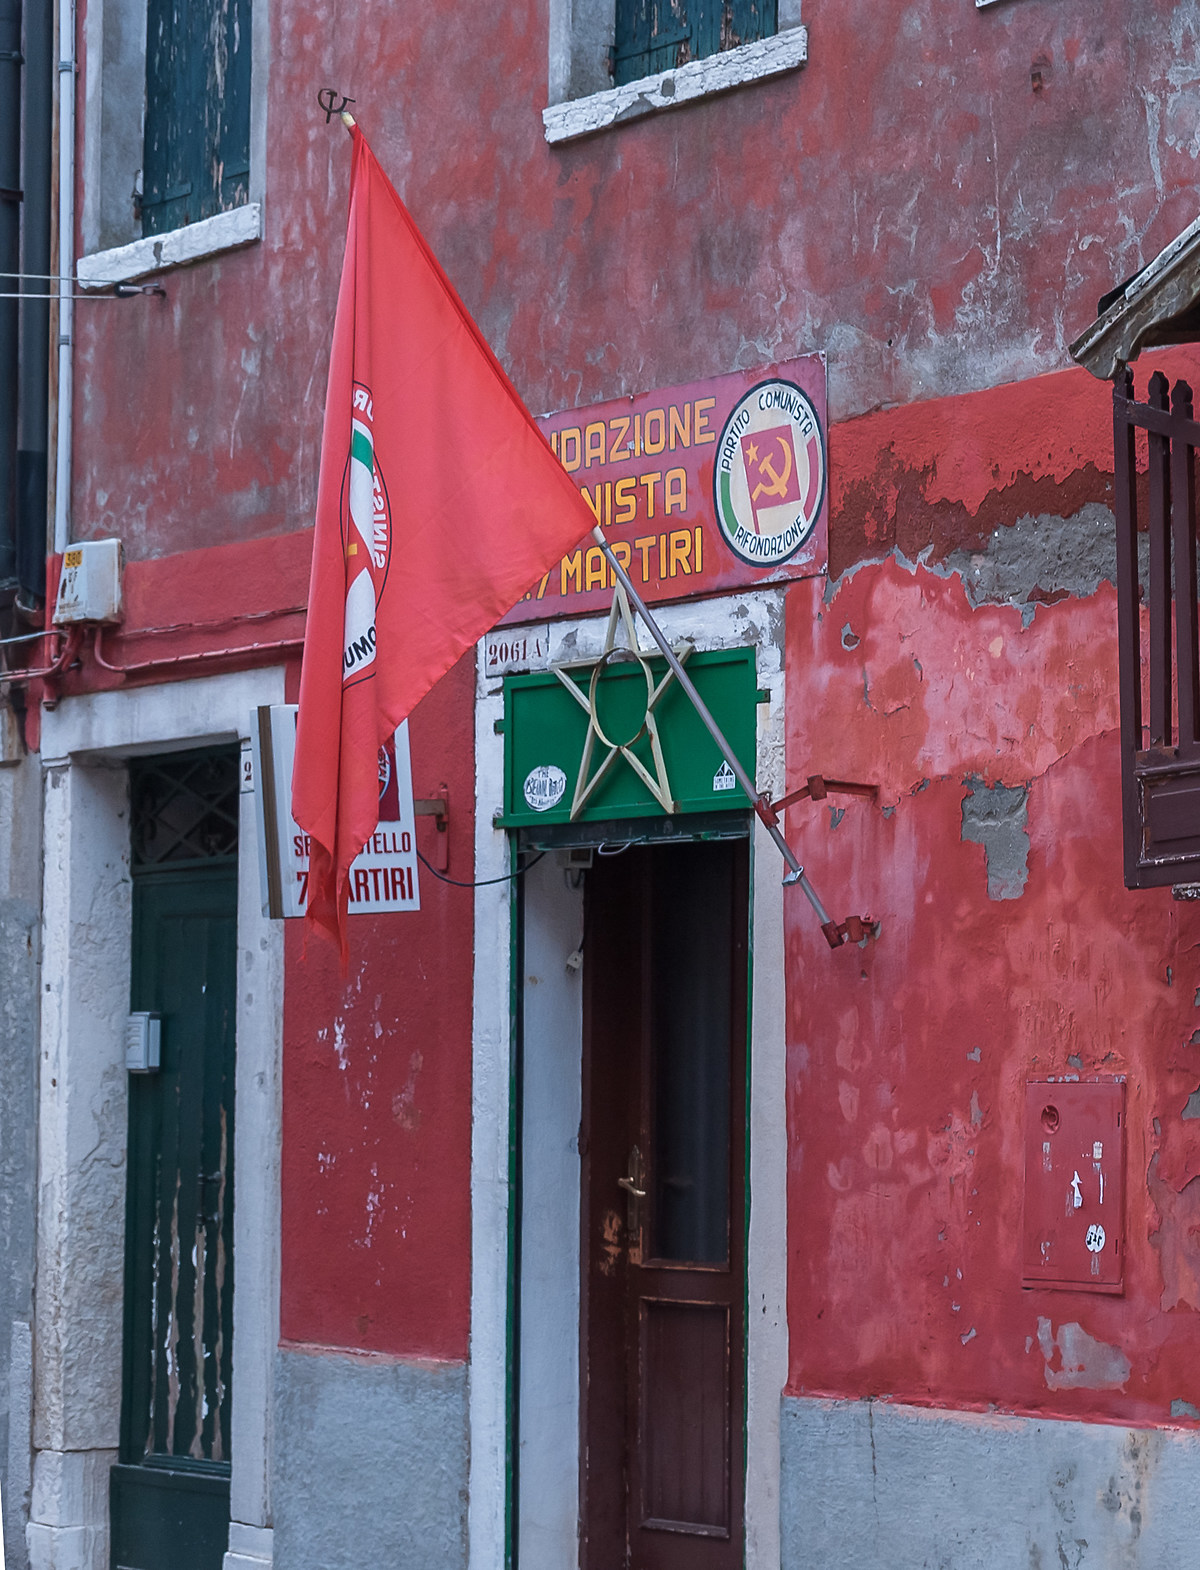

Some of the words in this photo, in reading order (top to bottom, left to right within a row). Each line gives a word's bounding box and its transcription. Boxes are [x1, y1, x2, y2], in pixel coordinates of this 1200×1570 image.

[721, 408, 750, 472] PARTITO
[758, 390, 813, 438] COMUNISTA
[734, 514, 806, 557] RIFONDAZIONE
[488, 639, 527, 666] 2061
